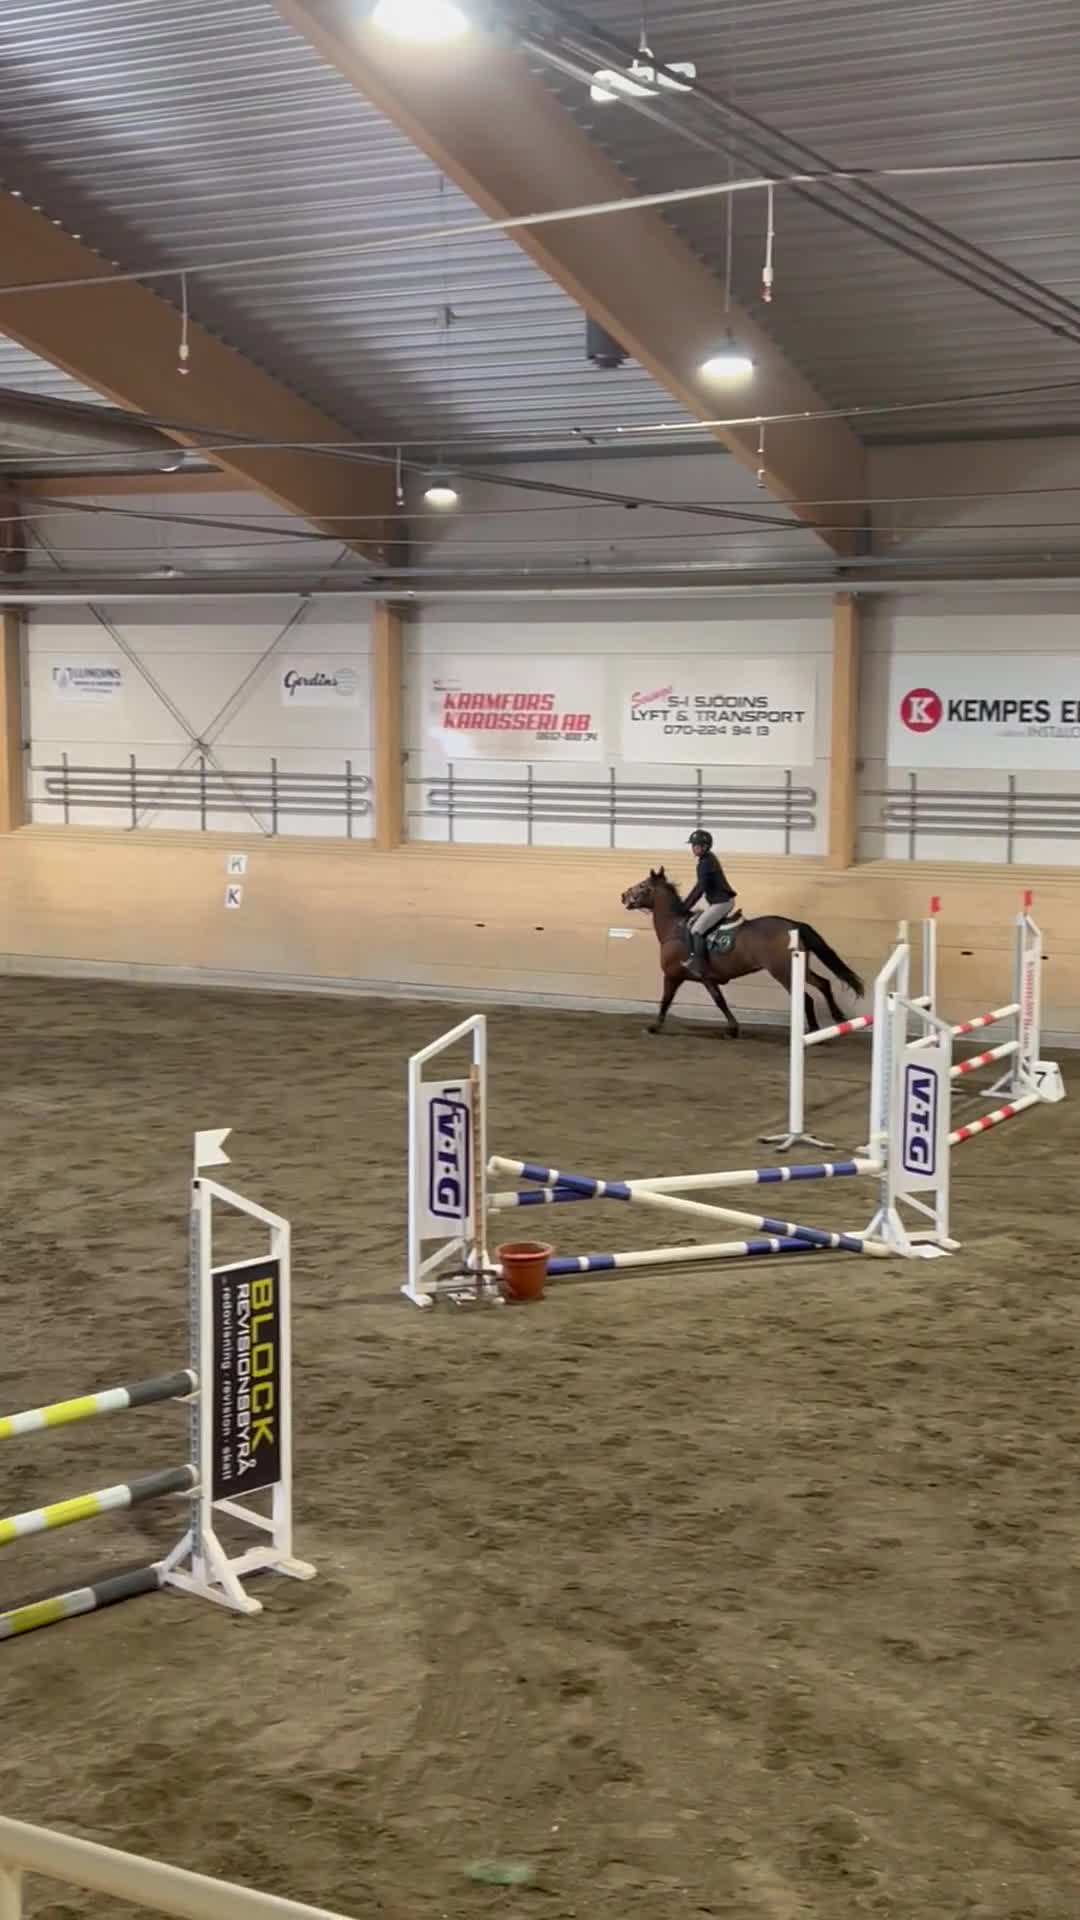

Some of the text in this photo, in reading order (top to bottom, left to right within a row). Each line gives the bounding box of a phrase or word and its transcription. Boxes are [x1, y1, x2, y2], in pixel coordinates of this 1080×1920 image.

[444, 693, 555, 711] KRAMFORS
[695, 694, 768, 708] SJÖDINS
[631, 710, 805, 723] LYFT & TRANSPORT
[948, 700, 1080, 723] KEMPES E
[443, 712, 591, 731] KAROSSERI AB
[663, 724, 727, 735] 070-224
[227, 887, 240, 905] K
[1034, 1071, 1046, 1088] 7
[251, 1277, 274, 1452] BLOCK
[236, 1283, 256, 1477] REVISIONSBYRÅ
